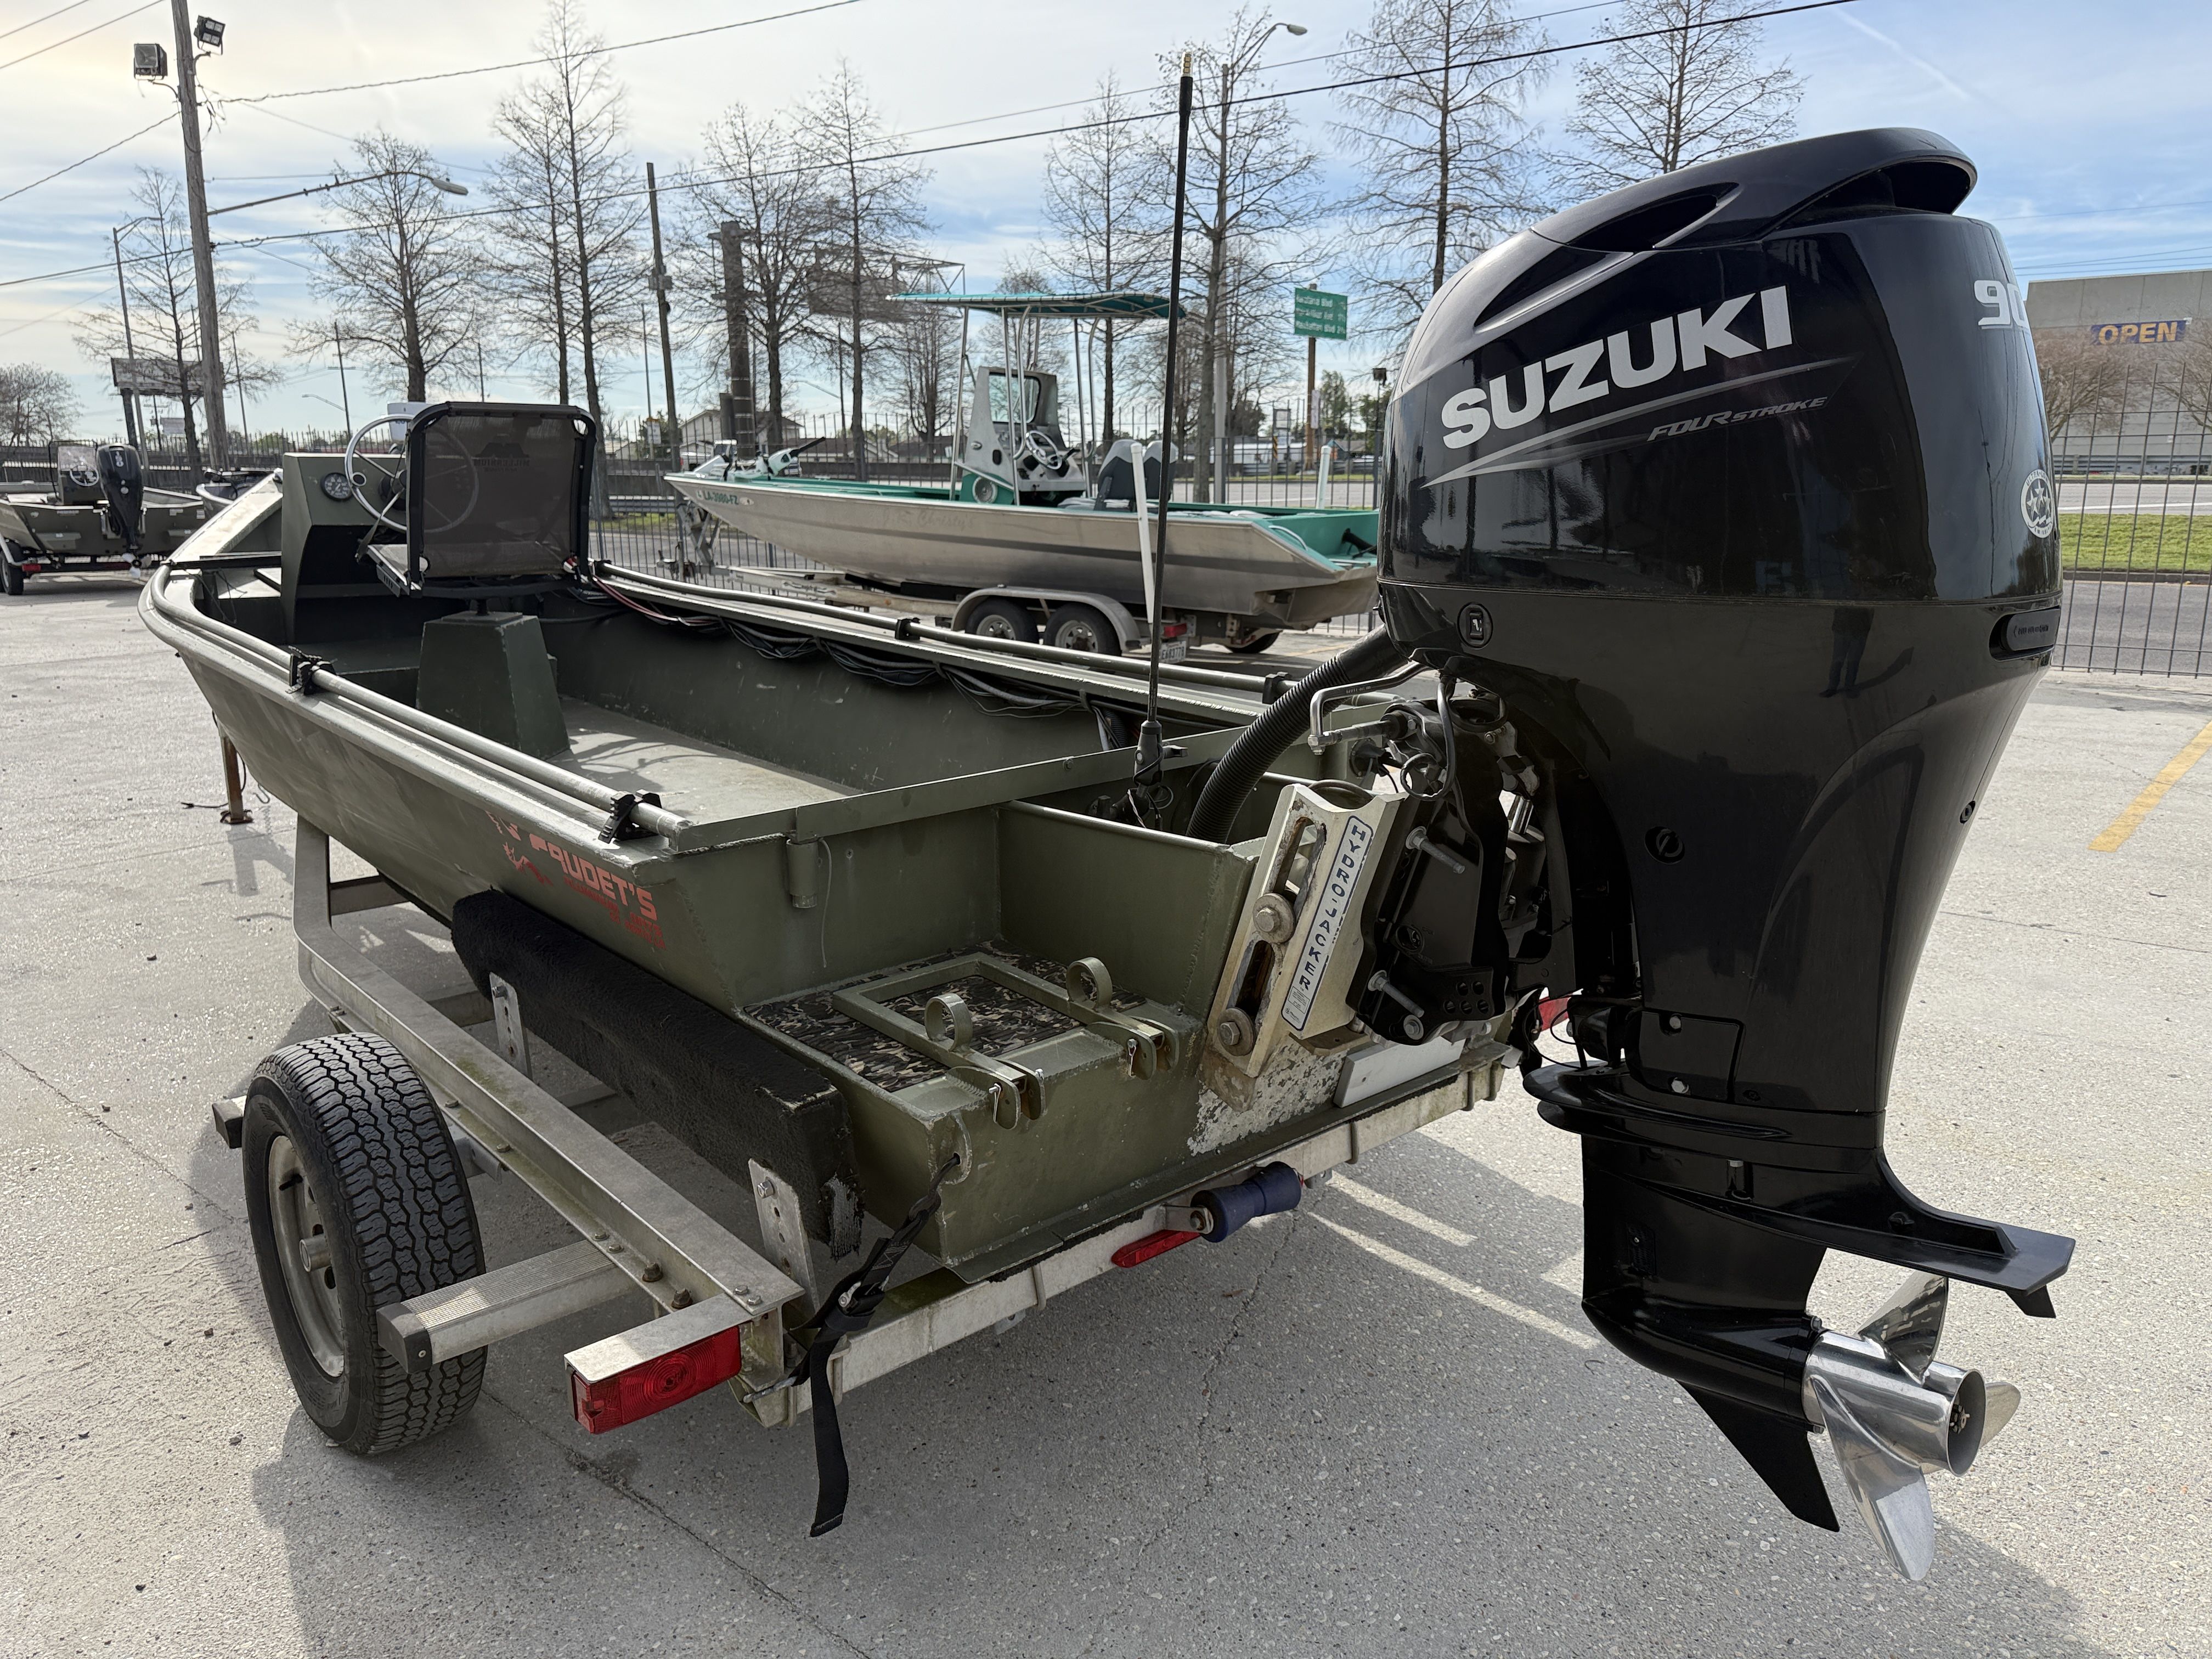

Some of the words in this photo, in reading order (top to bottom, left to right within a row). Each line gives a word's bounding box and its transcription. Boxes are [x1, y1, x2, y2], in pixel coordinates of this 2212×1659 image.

[1441, 285, 1793, 449] SUZUKI
[2098, 321, 2178, 345] OPEN
[1299, 825, 1366, 991] HYDRO-JACKER
